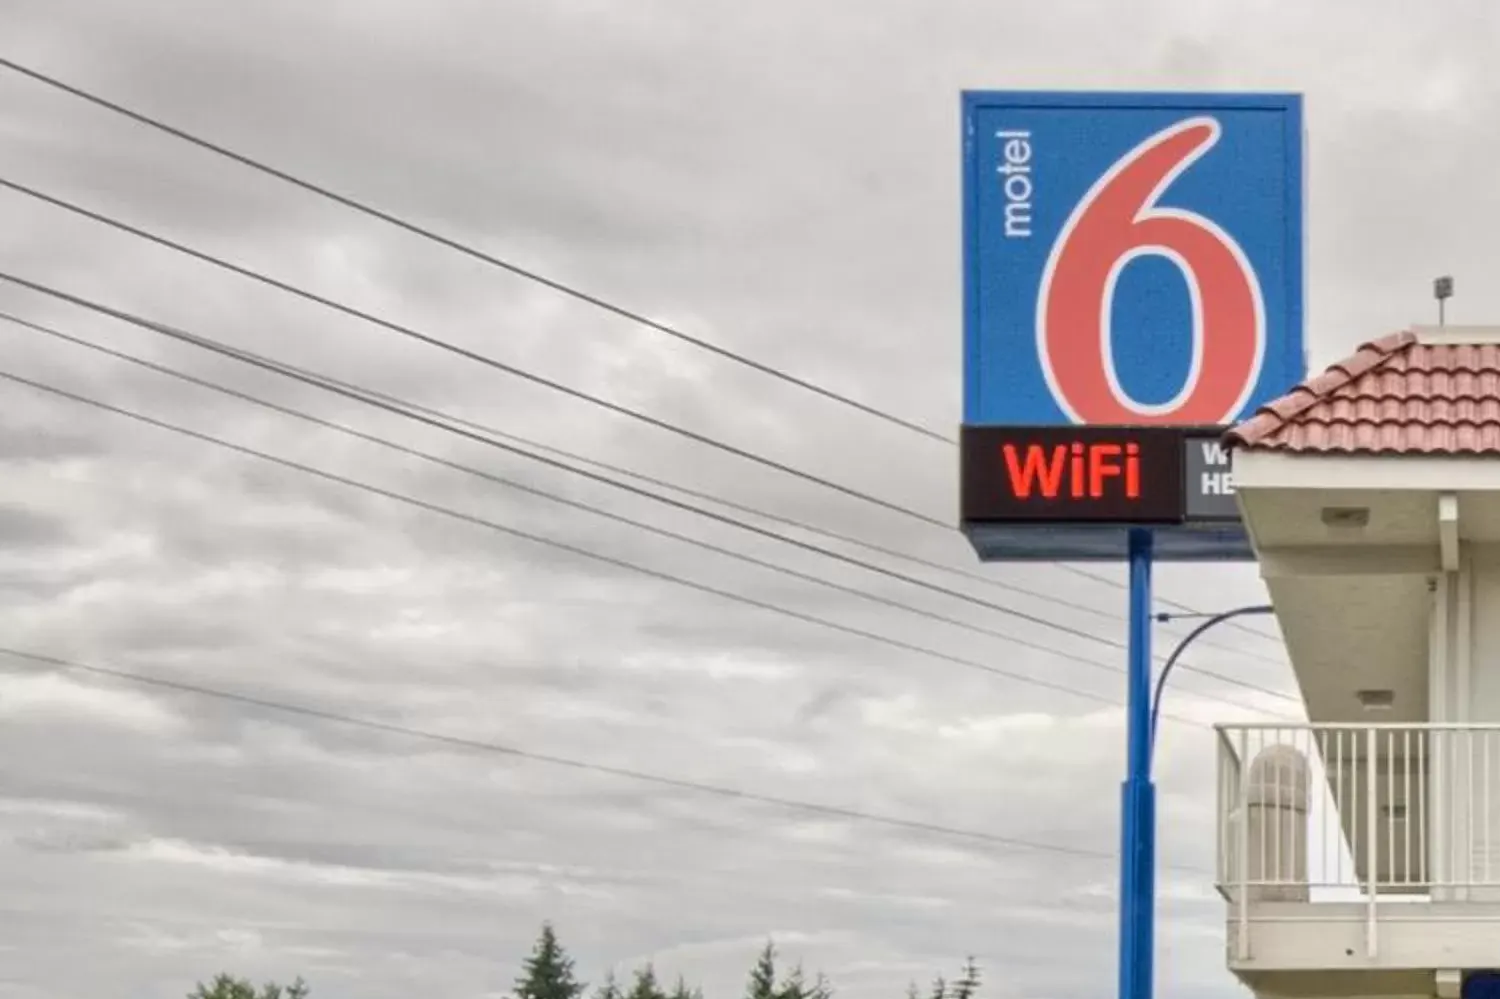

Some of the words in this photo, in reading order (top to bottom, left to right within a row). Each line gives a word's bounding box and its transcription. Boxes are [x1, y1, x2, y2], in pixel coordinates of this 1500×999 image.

[995, 130, 1032, 236] motel
[1035, 115, 1267, 426] 6
[1002, 441, 1140, 498] WiFi
